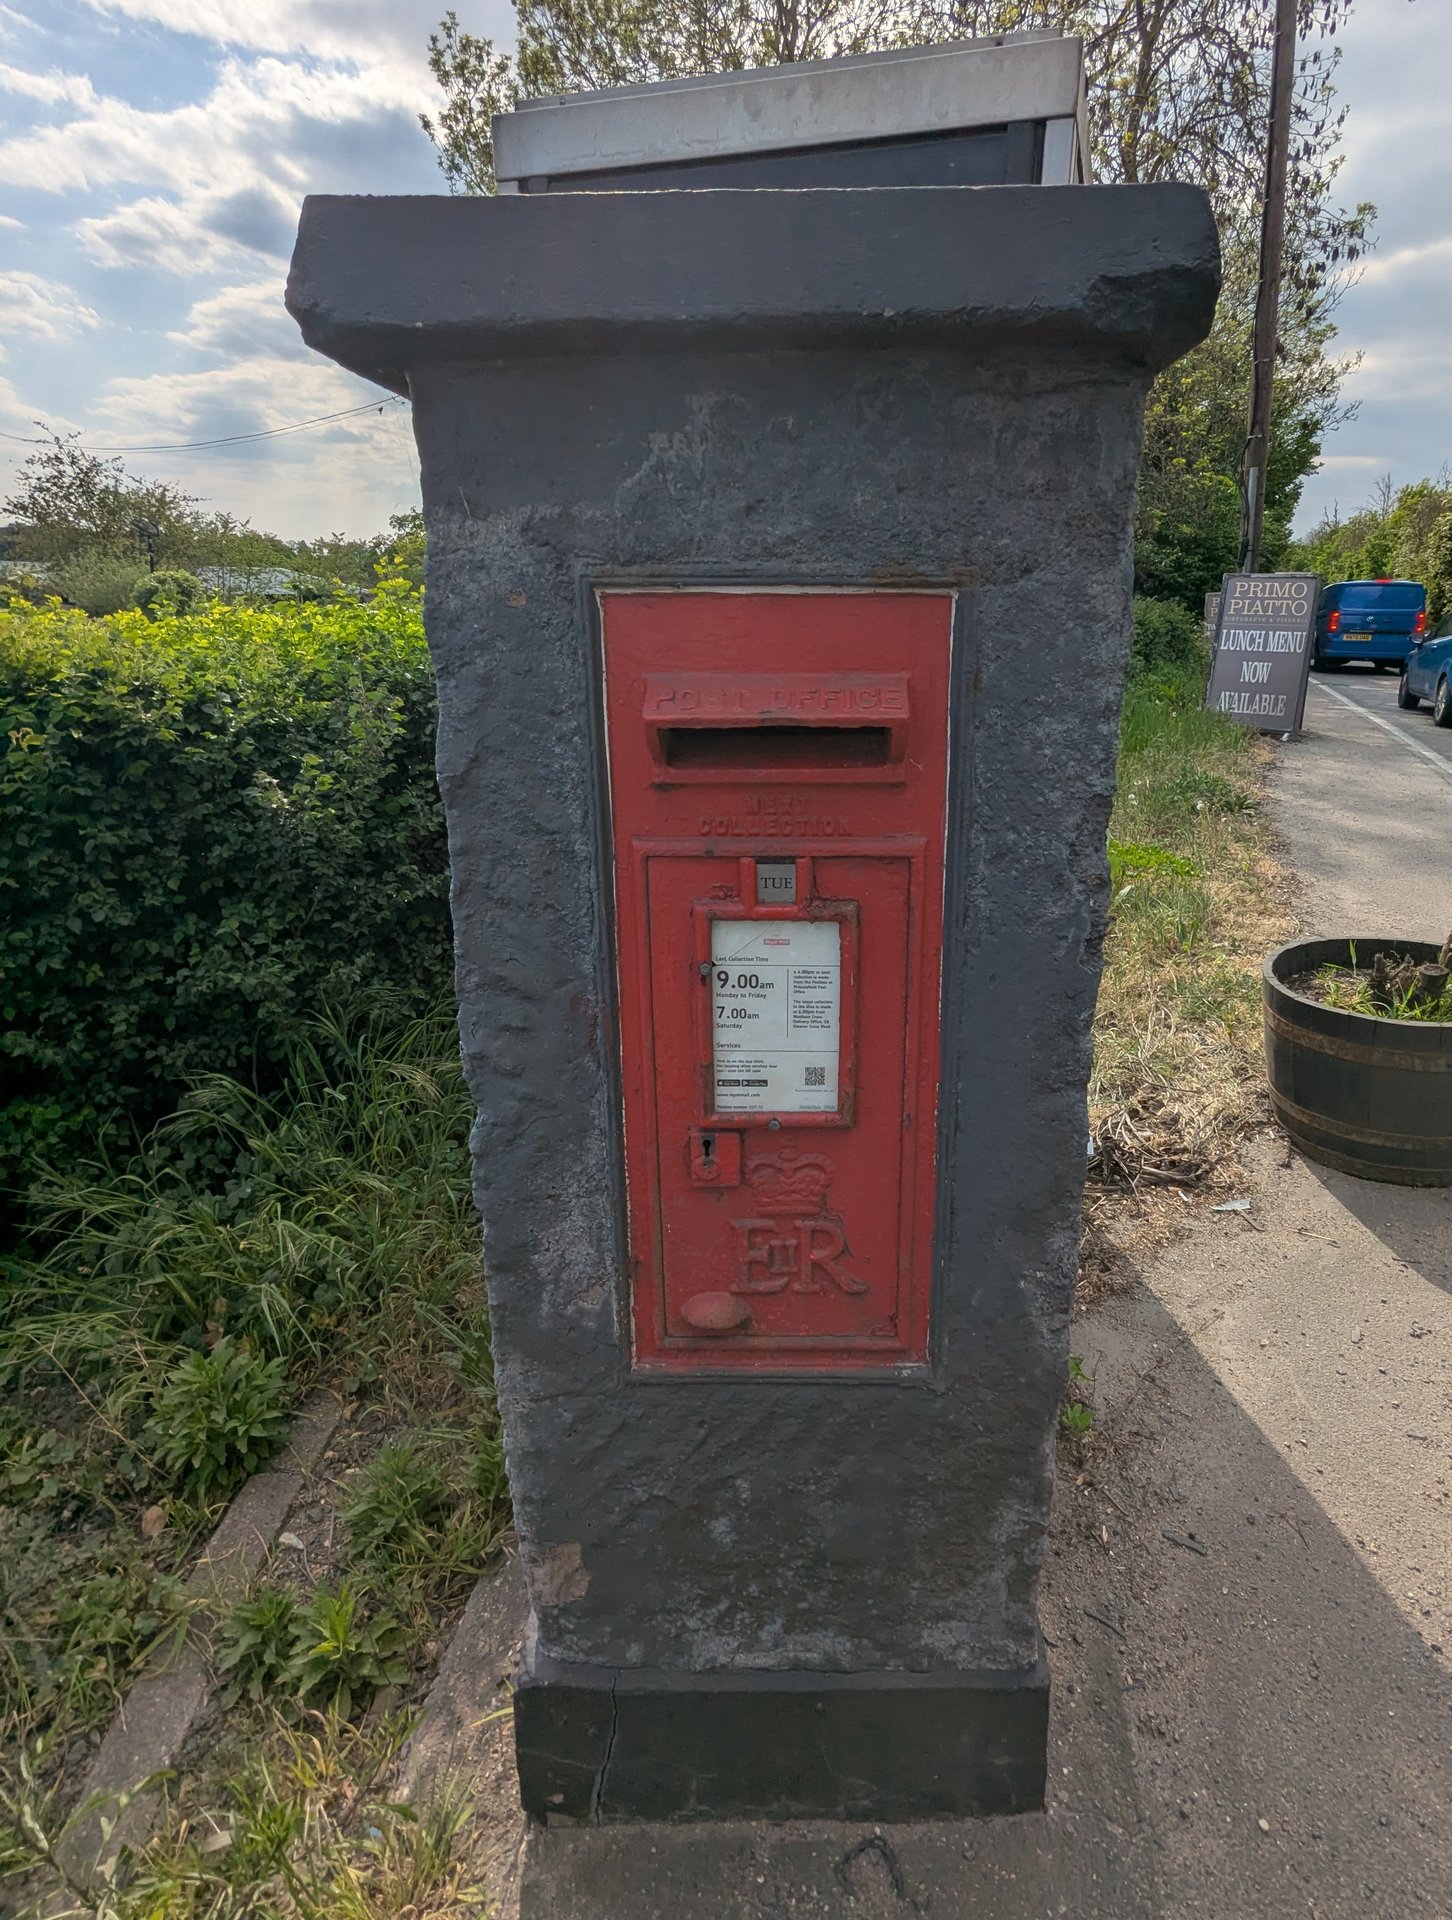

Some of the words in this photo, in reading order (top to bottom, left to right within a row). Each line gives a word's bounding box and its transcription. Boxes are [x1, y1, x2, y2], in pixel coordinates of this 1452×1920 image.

[1233, 581, 1308, 598] PRIMO
[1227, 599, 1308, 616] PIATTO
[1220, 629, 1266, 652] LUNCH
[1265, 631, 1307, 653] MENU
[1239, 661, 1273, 684] NOW
[651, 688, 750, 713] POST
[768, 686, 904, 711] OFFICE
[1216, 691, 1287, 717] AVAILABLE
[746, 796, 809, 816] NEXT
[699, 815, 851, 837] COLLECTION
[760, 876, 793, 890] TUE
[716, 970, 774, 989] 9.00am
[716, 1006, 760, 1020] 7.00am
